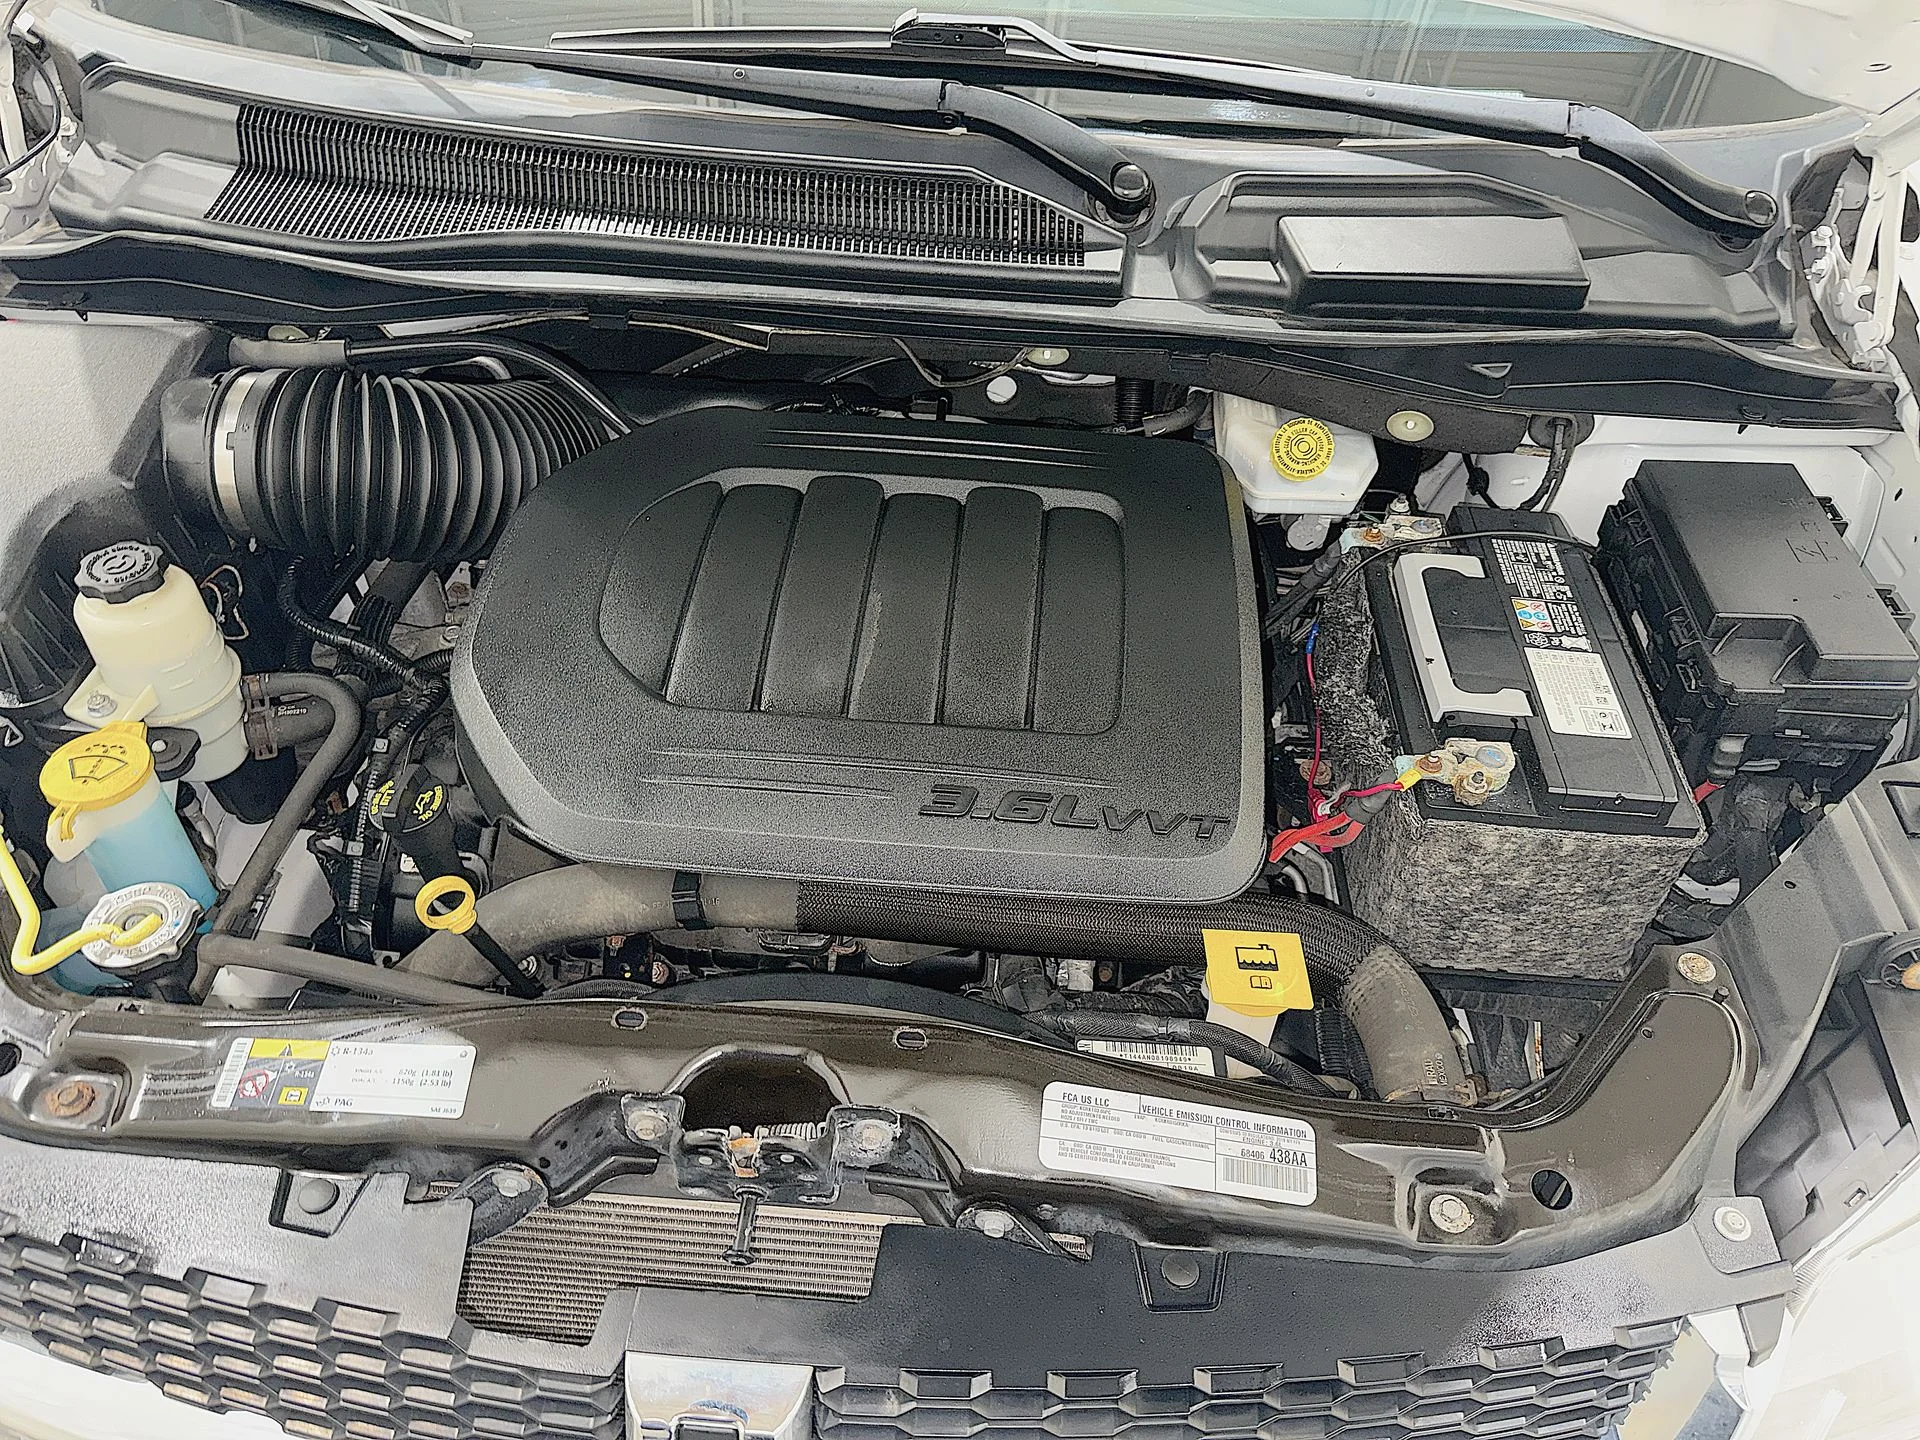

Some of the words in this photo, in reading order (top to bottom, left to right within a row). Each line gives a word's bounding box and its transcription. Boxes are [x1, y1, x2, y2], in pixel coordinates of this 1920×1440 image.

[418, 810, 434, 822] OIL
[333, 1098, 353, 1107] PAG
[1062, 1092, 1078, 1102] FCA
[1081, 1095, 1092, 1105] US
[1094, 1097, 1110, 1107] LLC
[1069, 1109, 1102, 1119] ADJUSTMENTS
[1142, 1104, 1174, 1118] VEHICLE
[1176, 1110, 1213, 1124] EMISSION
[1215, 1116, 1250, 1130] CONTROL
[1253, 1122, 1307, 1139] INFORMATION
[1070, 1147, 1088, 1155] VEHICLE
[1123, 1154, 1144, 1163] FEDERAL
[1145, 1157, 1176, 1168] REGULATIONS
[1074, 1153, 1098, 1162] CERTIFIED
[1269, 1148, 1307, 1167] 438AA
